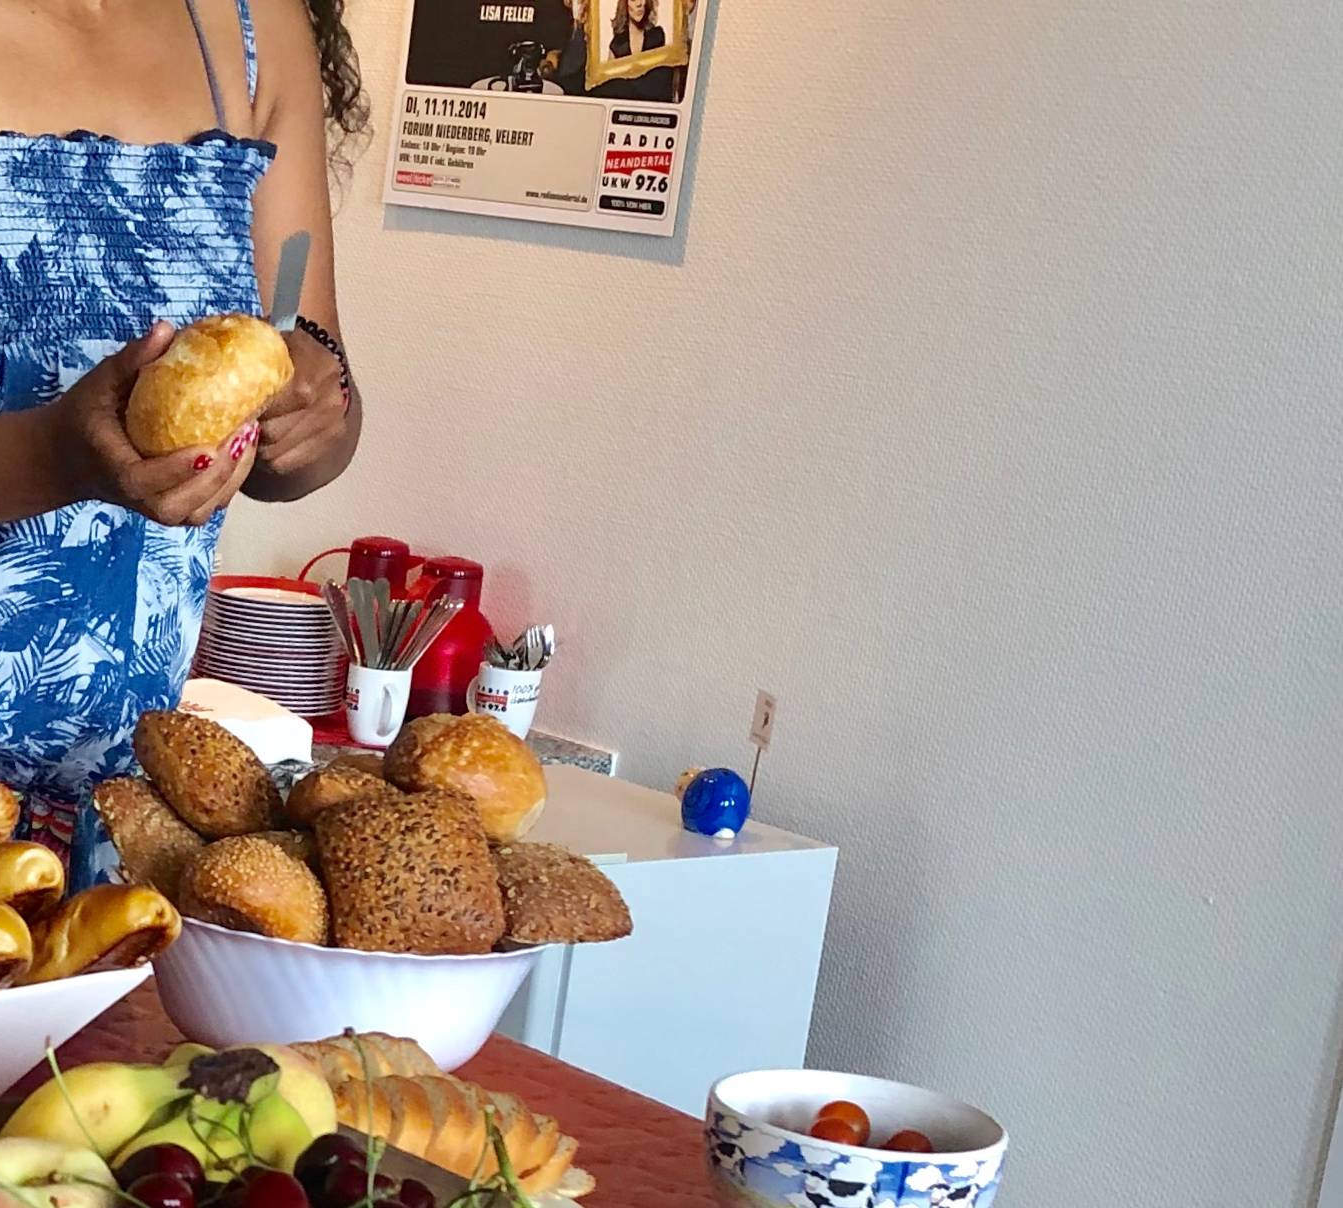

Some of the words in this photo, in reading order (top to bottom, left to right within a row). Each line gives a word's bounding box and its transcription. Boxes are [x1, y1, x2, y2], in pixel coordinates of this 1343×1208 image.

[480, 5, 501, 21] LISA
[503, 6, 535, 23] FELLER
[406, 96, 420, 117] DI,
[424, 97, 487, 119] 11.11.2014
[403, 122, 434, 137] FORUM
[436, 124, 493, 145] NIEDERBERG,
[496, 129, 534, 146] VELBERT
[608, 132, 675, 150] RADIO
[606, 155, 670, 169] NEANDERTAL
[602, 176, 631, 189] UKW
[635, 174, 669, 193] 97.6
